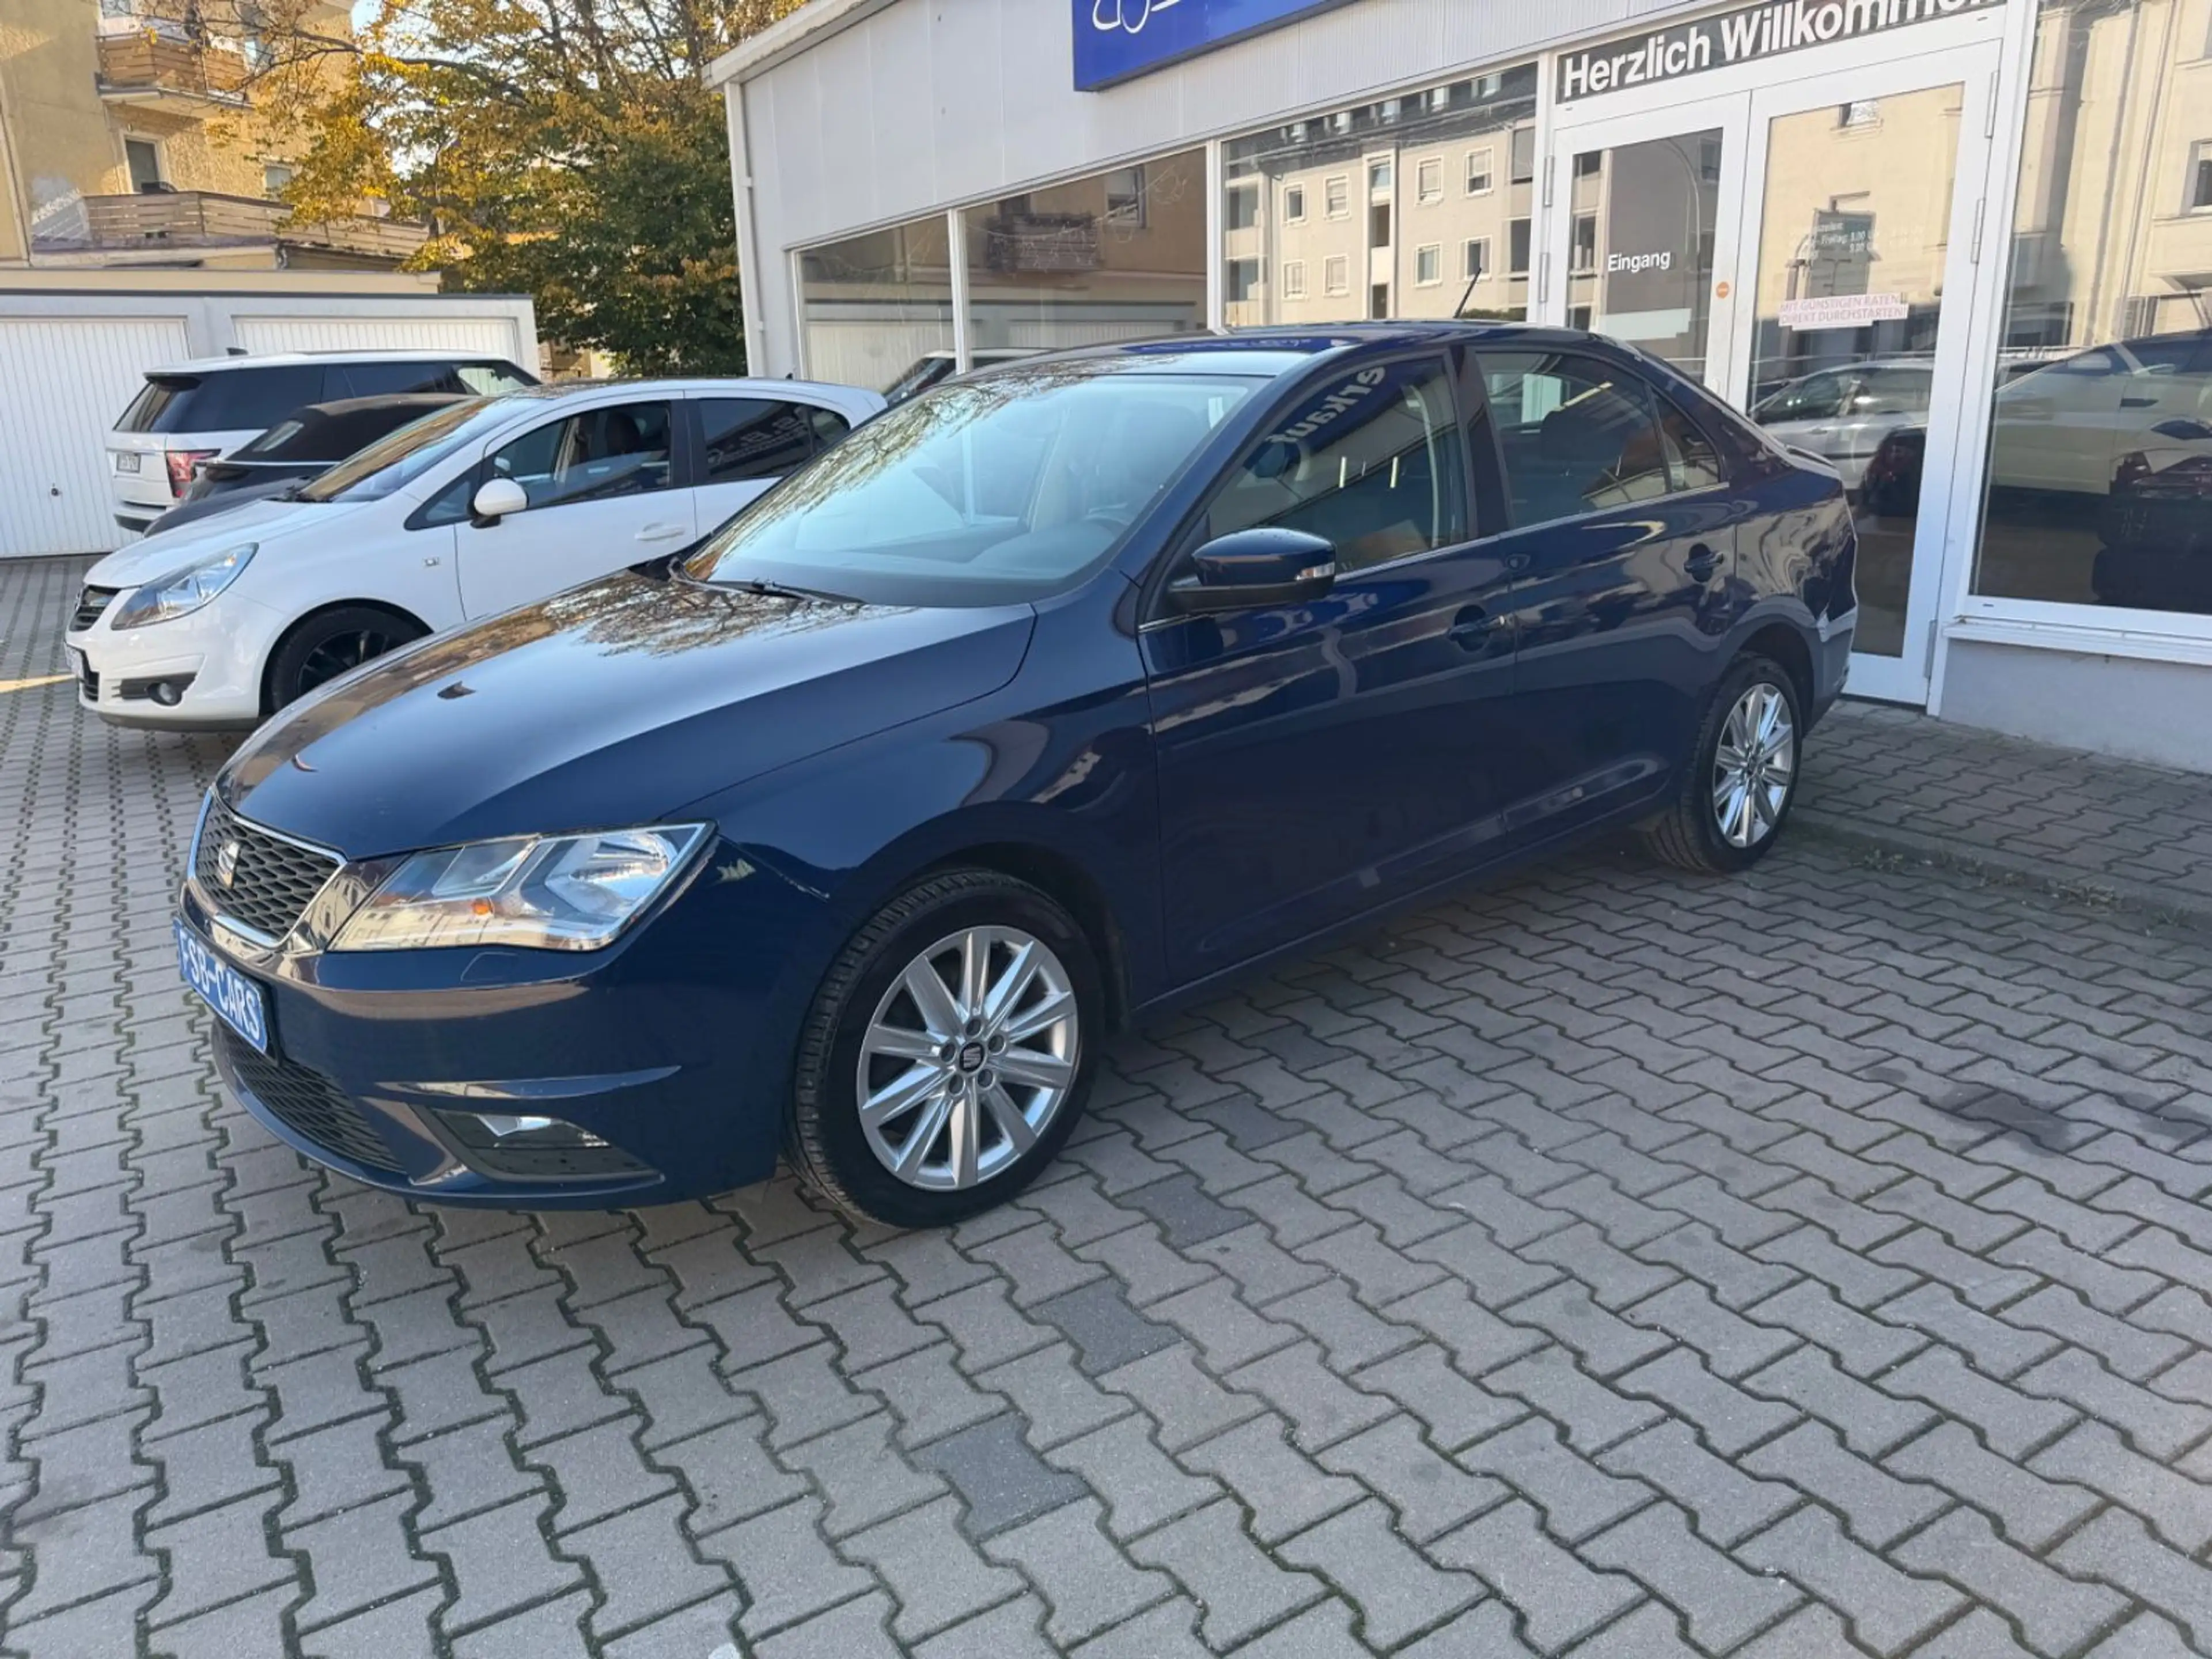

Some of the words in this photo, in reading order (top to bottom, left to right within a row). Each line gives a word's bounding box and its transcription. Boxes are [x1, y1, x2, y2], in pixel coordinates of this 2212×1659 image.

[1563, 28, 1710, 99] Herzlich
[1608, 251, 1671, 274] Eingang
[179, 929, 260, 1040] FSB-CARS
